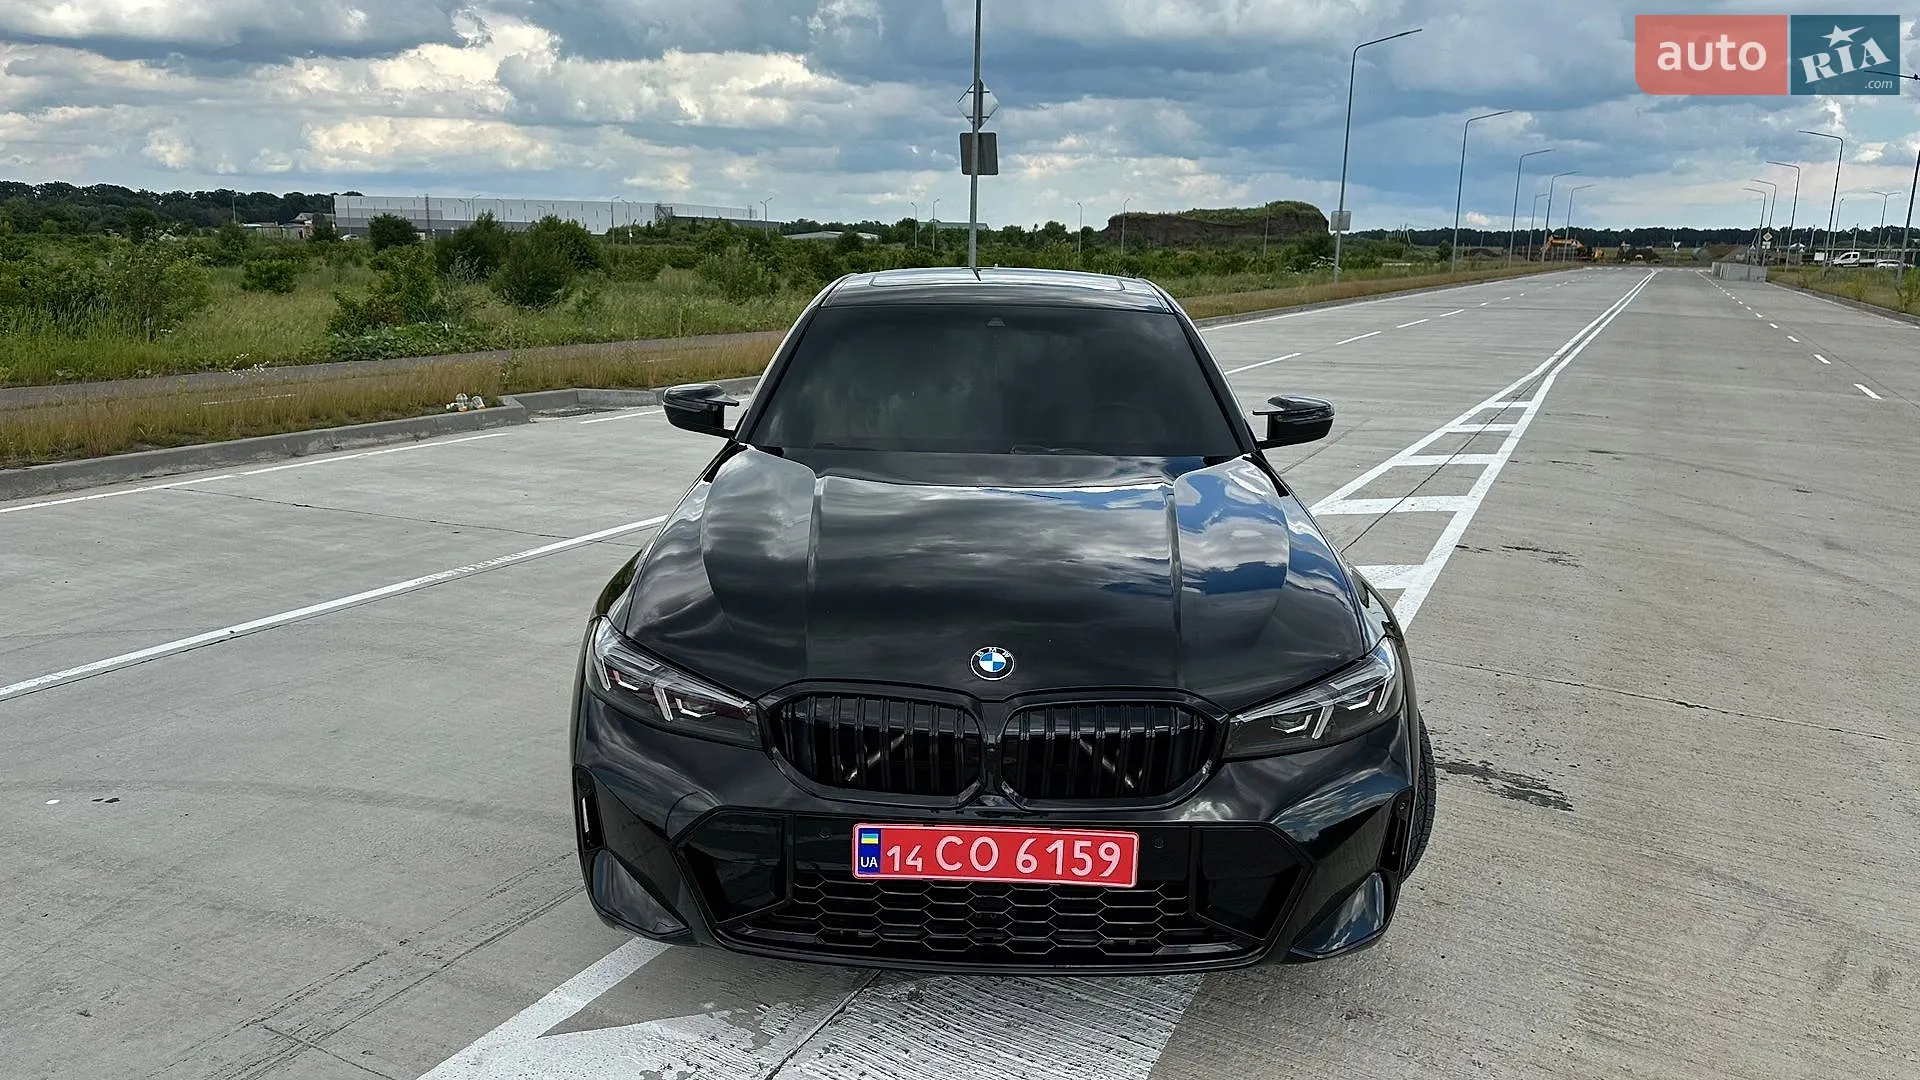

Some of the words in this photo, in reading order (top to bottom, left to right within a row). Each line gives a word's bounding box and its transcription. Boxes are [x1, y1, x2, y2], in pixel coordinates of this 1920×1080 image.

[860, 856, 878, 868] UA
[887, 845, 923, 873] 14
[935, 835, 999, 872] CO
[1015, 838, 1121, 877] 6159
